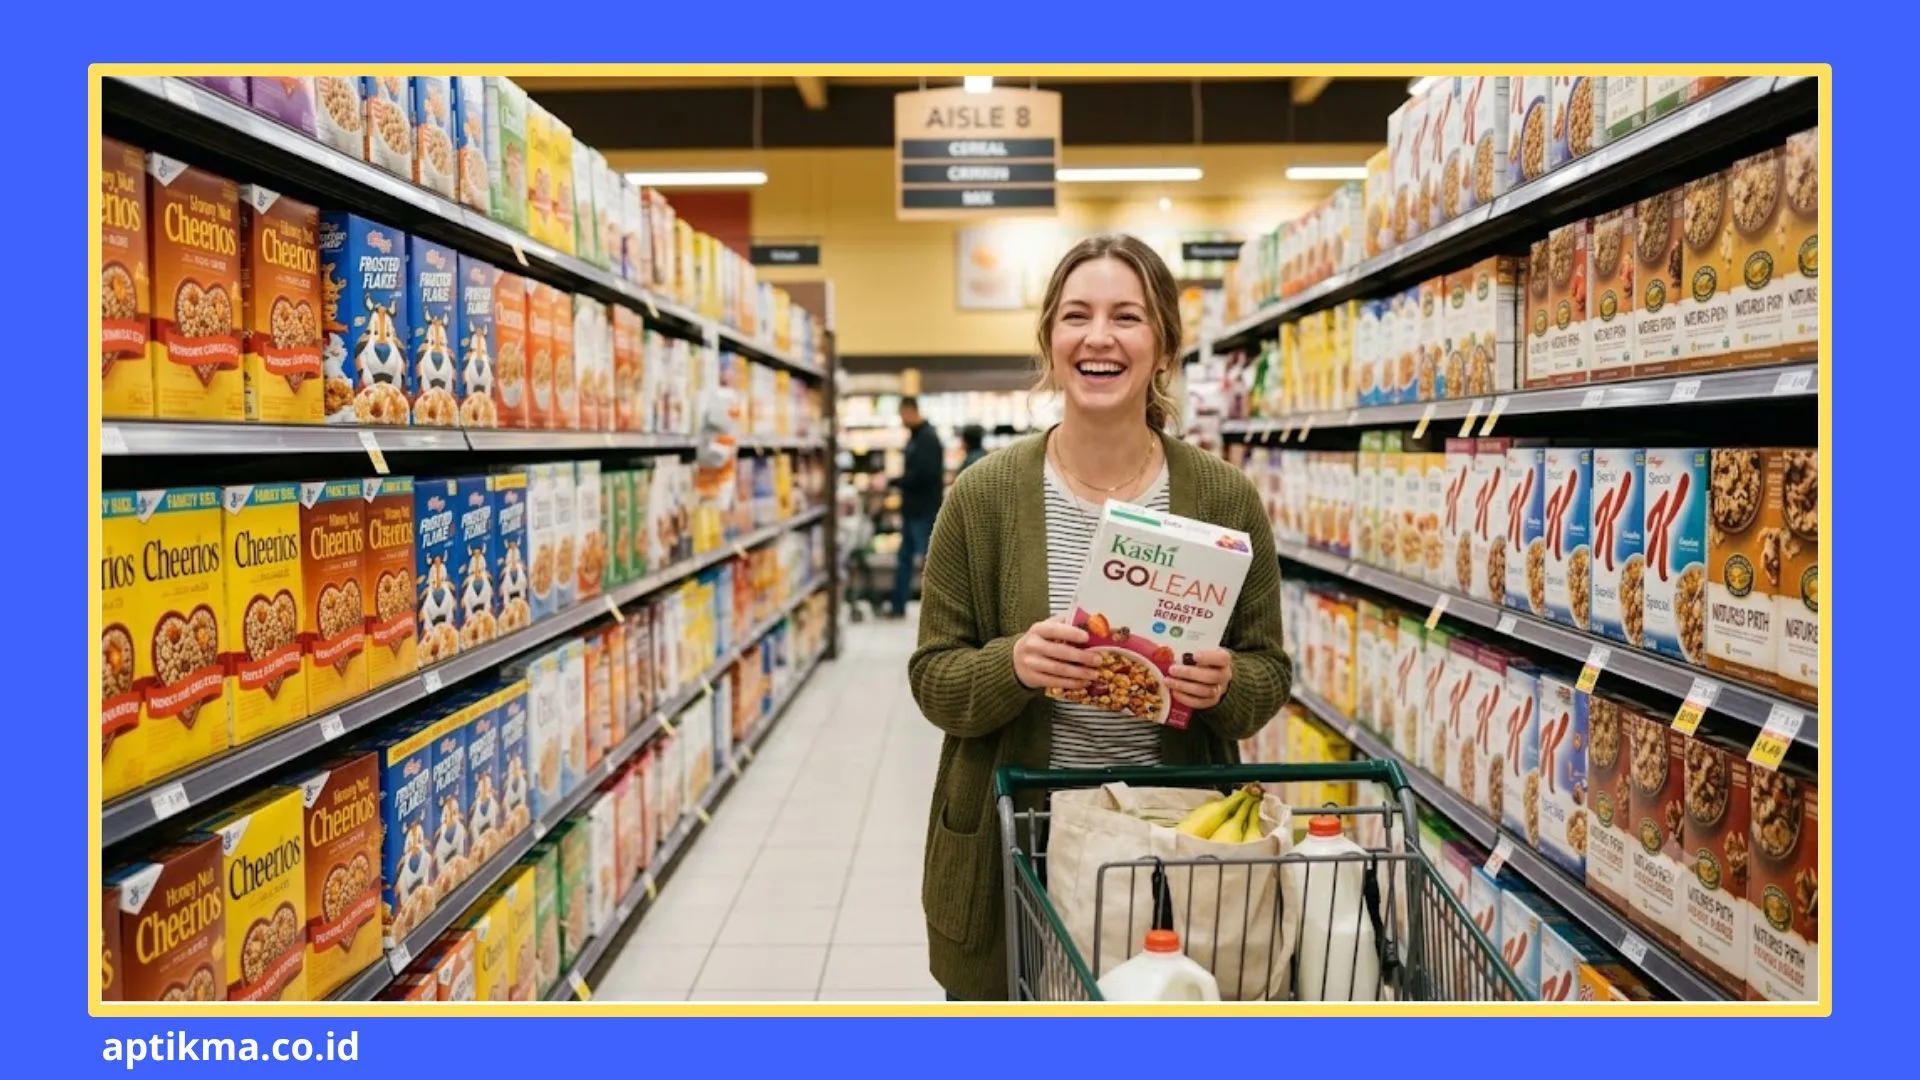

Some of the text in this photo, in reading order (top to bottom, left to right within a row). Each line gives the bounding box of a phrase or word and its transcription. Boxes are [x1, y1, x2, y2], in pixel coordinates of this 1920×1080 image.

[926, 106, 1031, 127] AISLE 8
[164, 201, 236, 256] Cheerios
[1507, 467, 1533, 552] K
[1546, 469, 1577, 561] K
[1594, 471, 1632, 571] K
[1646, 472, 1690, 582] K
[143, 538, 220, 582] Cheerios
[234, 530, 298, 568] Cheerios
[1111, 534, 1176, 567] Kashi
[1103, 559, 1228, 607] GOLEAN
[1158, 598, 1214, 619] TOASTED
[1507, 696, 1532, 777] K
[1540, 712, 1569, 793] K
[310, 792, 375, 849] Cheerios
[229, 834, 301, 901] Cheerios
[136, 885, 222, 965] Cheerios
